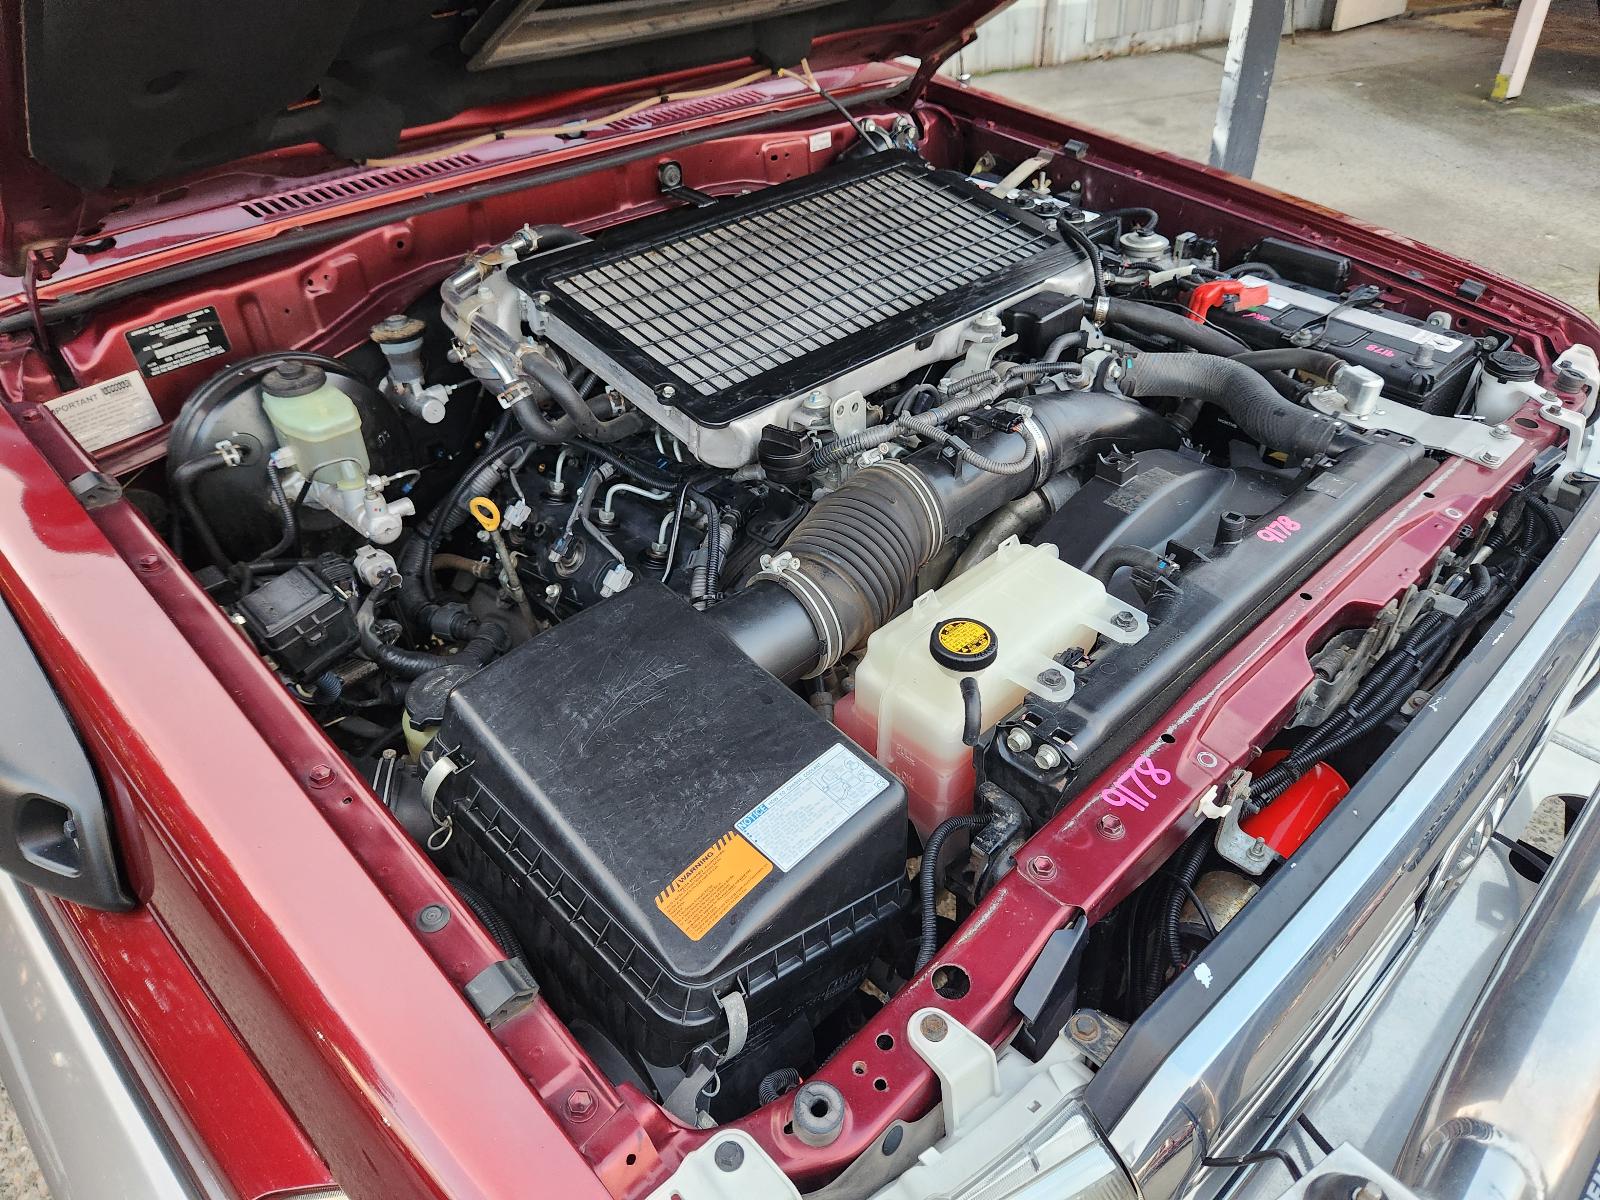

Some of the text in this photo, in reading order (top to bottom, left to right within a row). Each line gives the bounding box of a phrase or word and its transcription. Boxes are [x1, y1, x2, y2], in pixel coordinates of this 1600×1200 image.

[1256, 515, 1302, 544] 9178
[1101, 755, 1171, 812] 9178
[737, 804, 768, 830] NOTICE
[679, 851, 714, 884] WARNING
